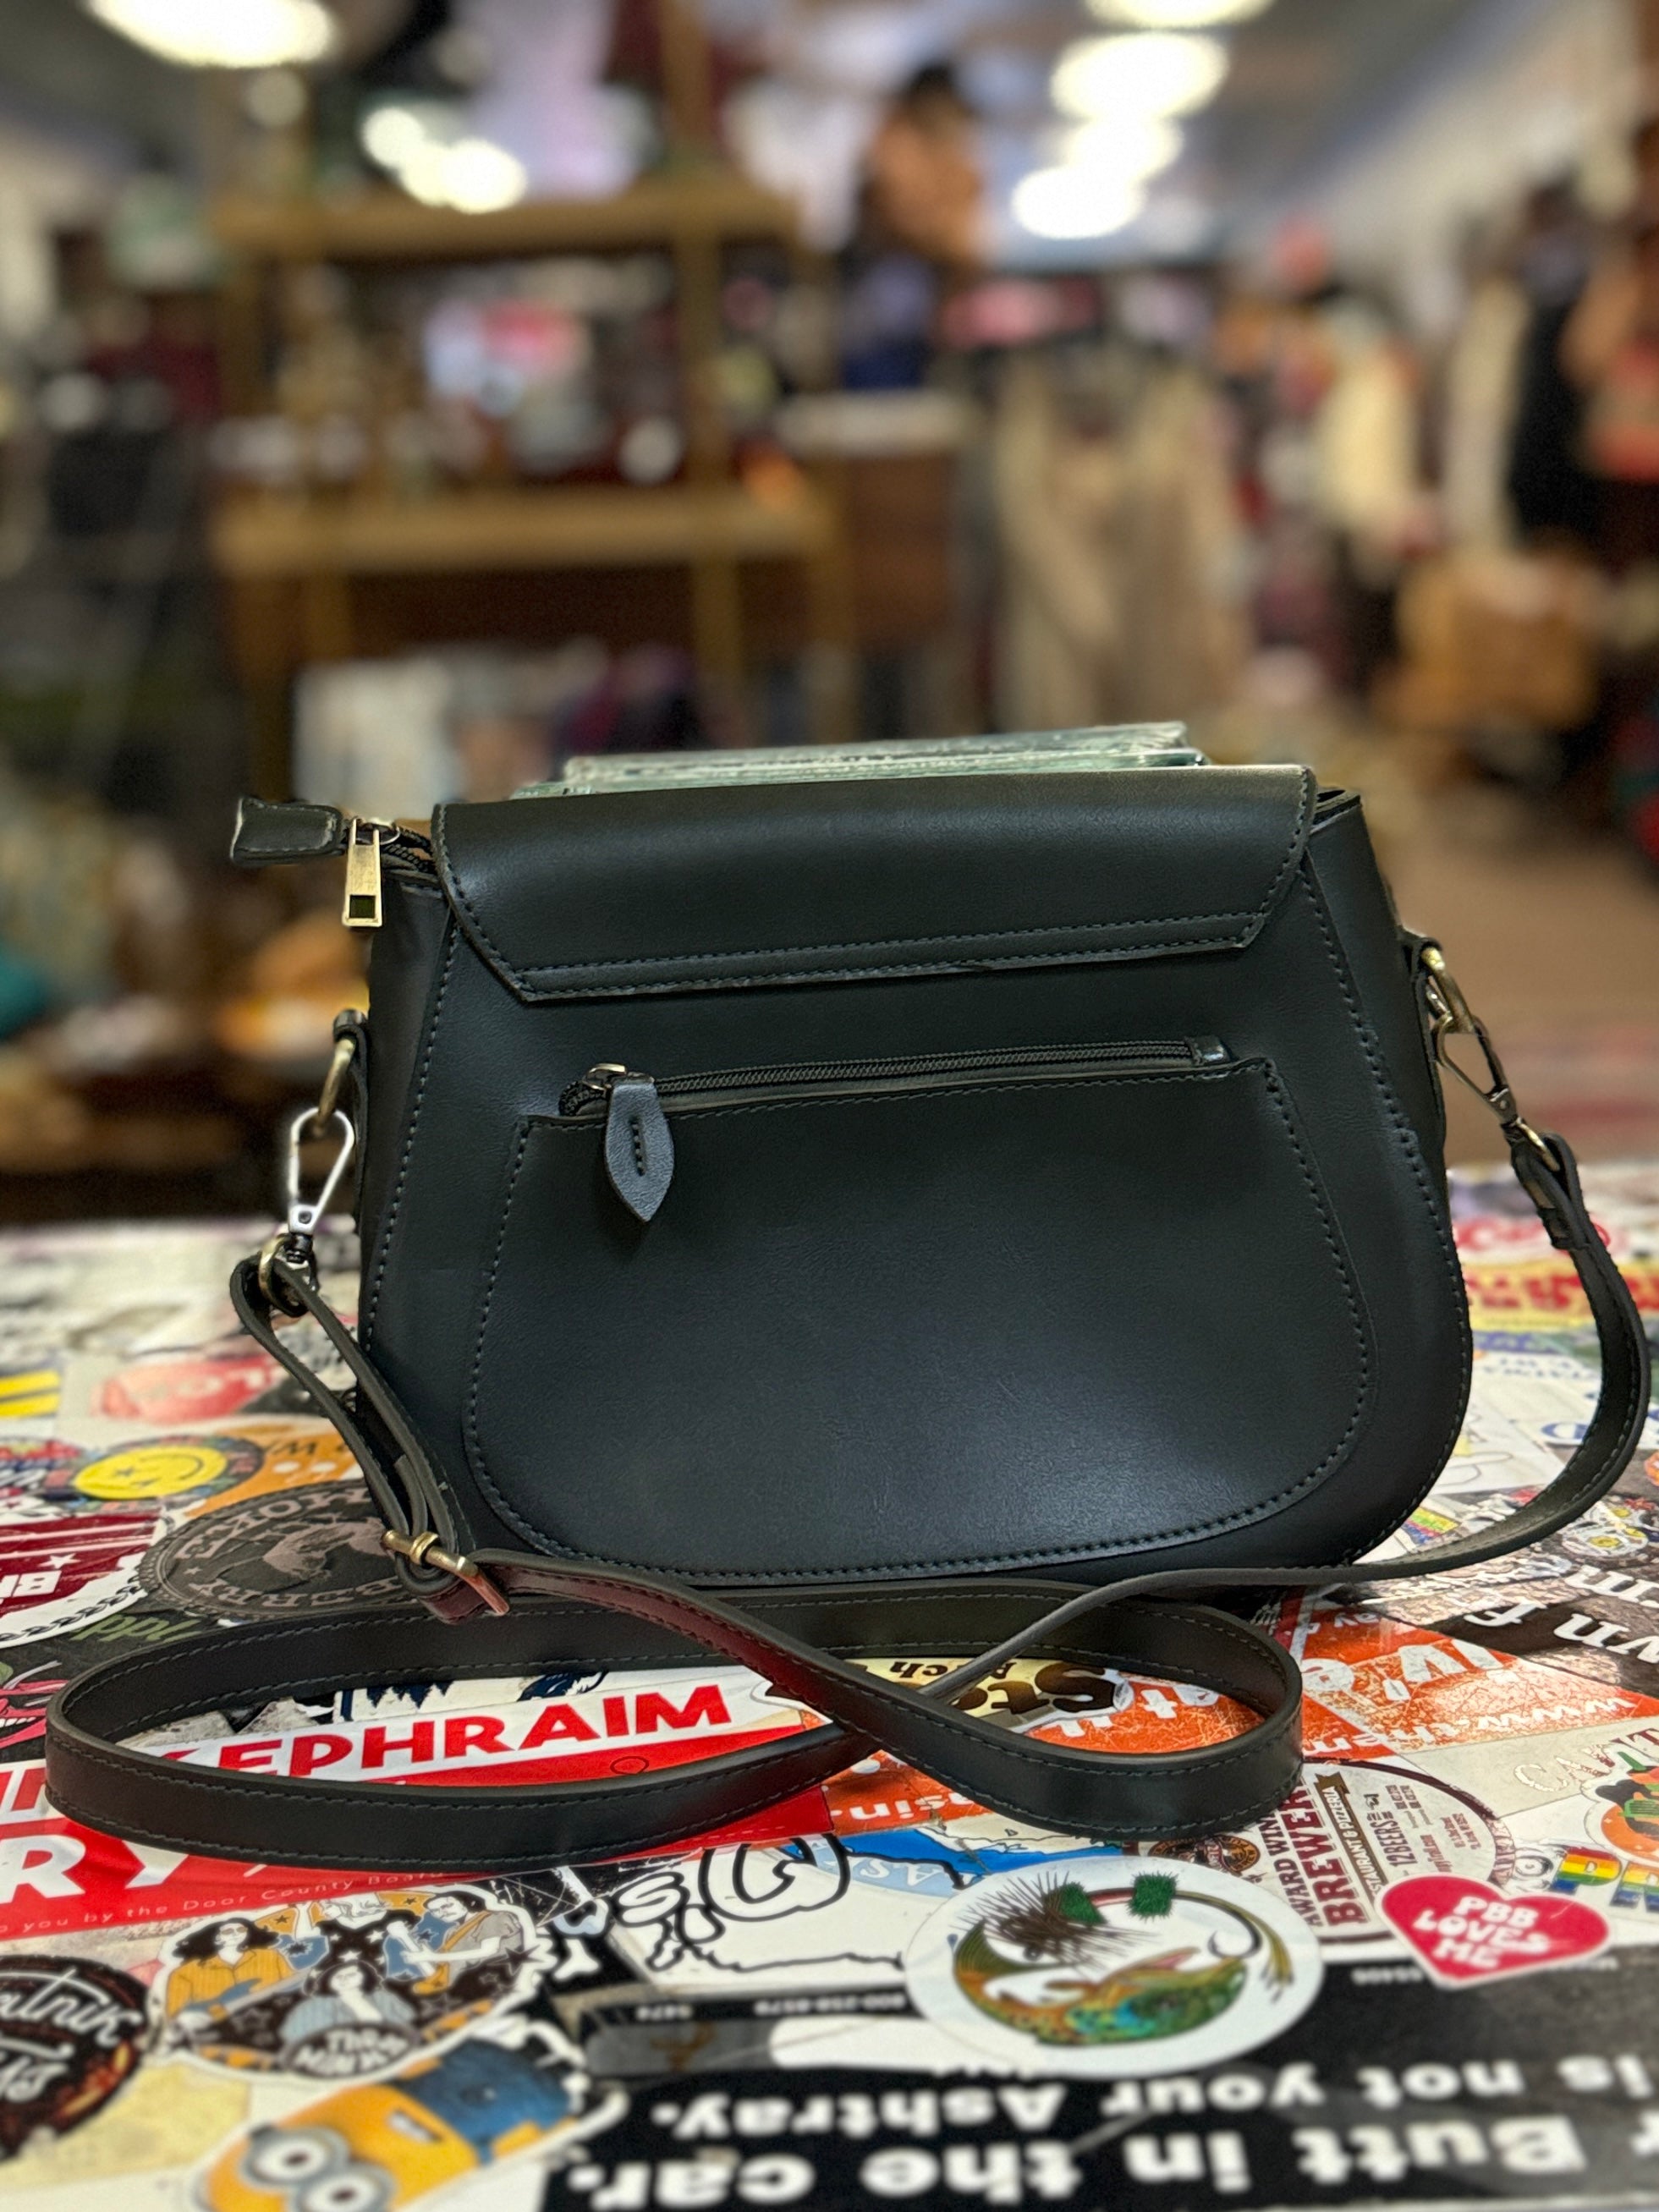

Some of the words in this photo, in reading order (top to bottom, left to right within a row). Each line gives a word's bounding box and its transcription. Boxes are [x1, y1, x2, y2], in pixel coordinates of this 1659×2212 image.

[218, 1684, 732, 1777] EPHRAIM
[1321, 1786, 1355, 1832] PIZZERIA
[1276, 1780, 1370, 1927] BREWER
[1349, 1838, 1383, 1897] STAURANT
[23, 1918, 69, 1934] you
[84, 1913, 113, 1924] by
[127, 1905, 168, 1918] the
[182, 1895, 248, 1911] Door
[261, 1878, 354, 1901] County
[1273, 1857, 1323, 1928] AWARD
[1452, 1894, 1539, 1928] PBB
[1412, 1907, 1550, 1954] LOVES
[1431, 1935, 1501, 1968] ME
[1101, 2061, 1326, 2119] your
[1358, 2060, 1526, 2109] not
[1557, 2053, 1655, 2099] is
[651, 2083, 1067, 2141] Ashtray.
[860, 2140, 1083, 2204] the
[1125, 2130, 1252, 2193] in
[1294, 2114, 1587, 2186] Butt
[569, 2153, 816, 2211] car.
